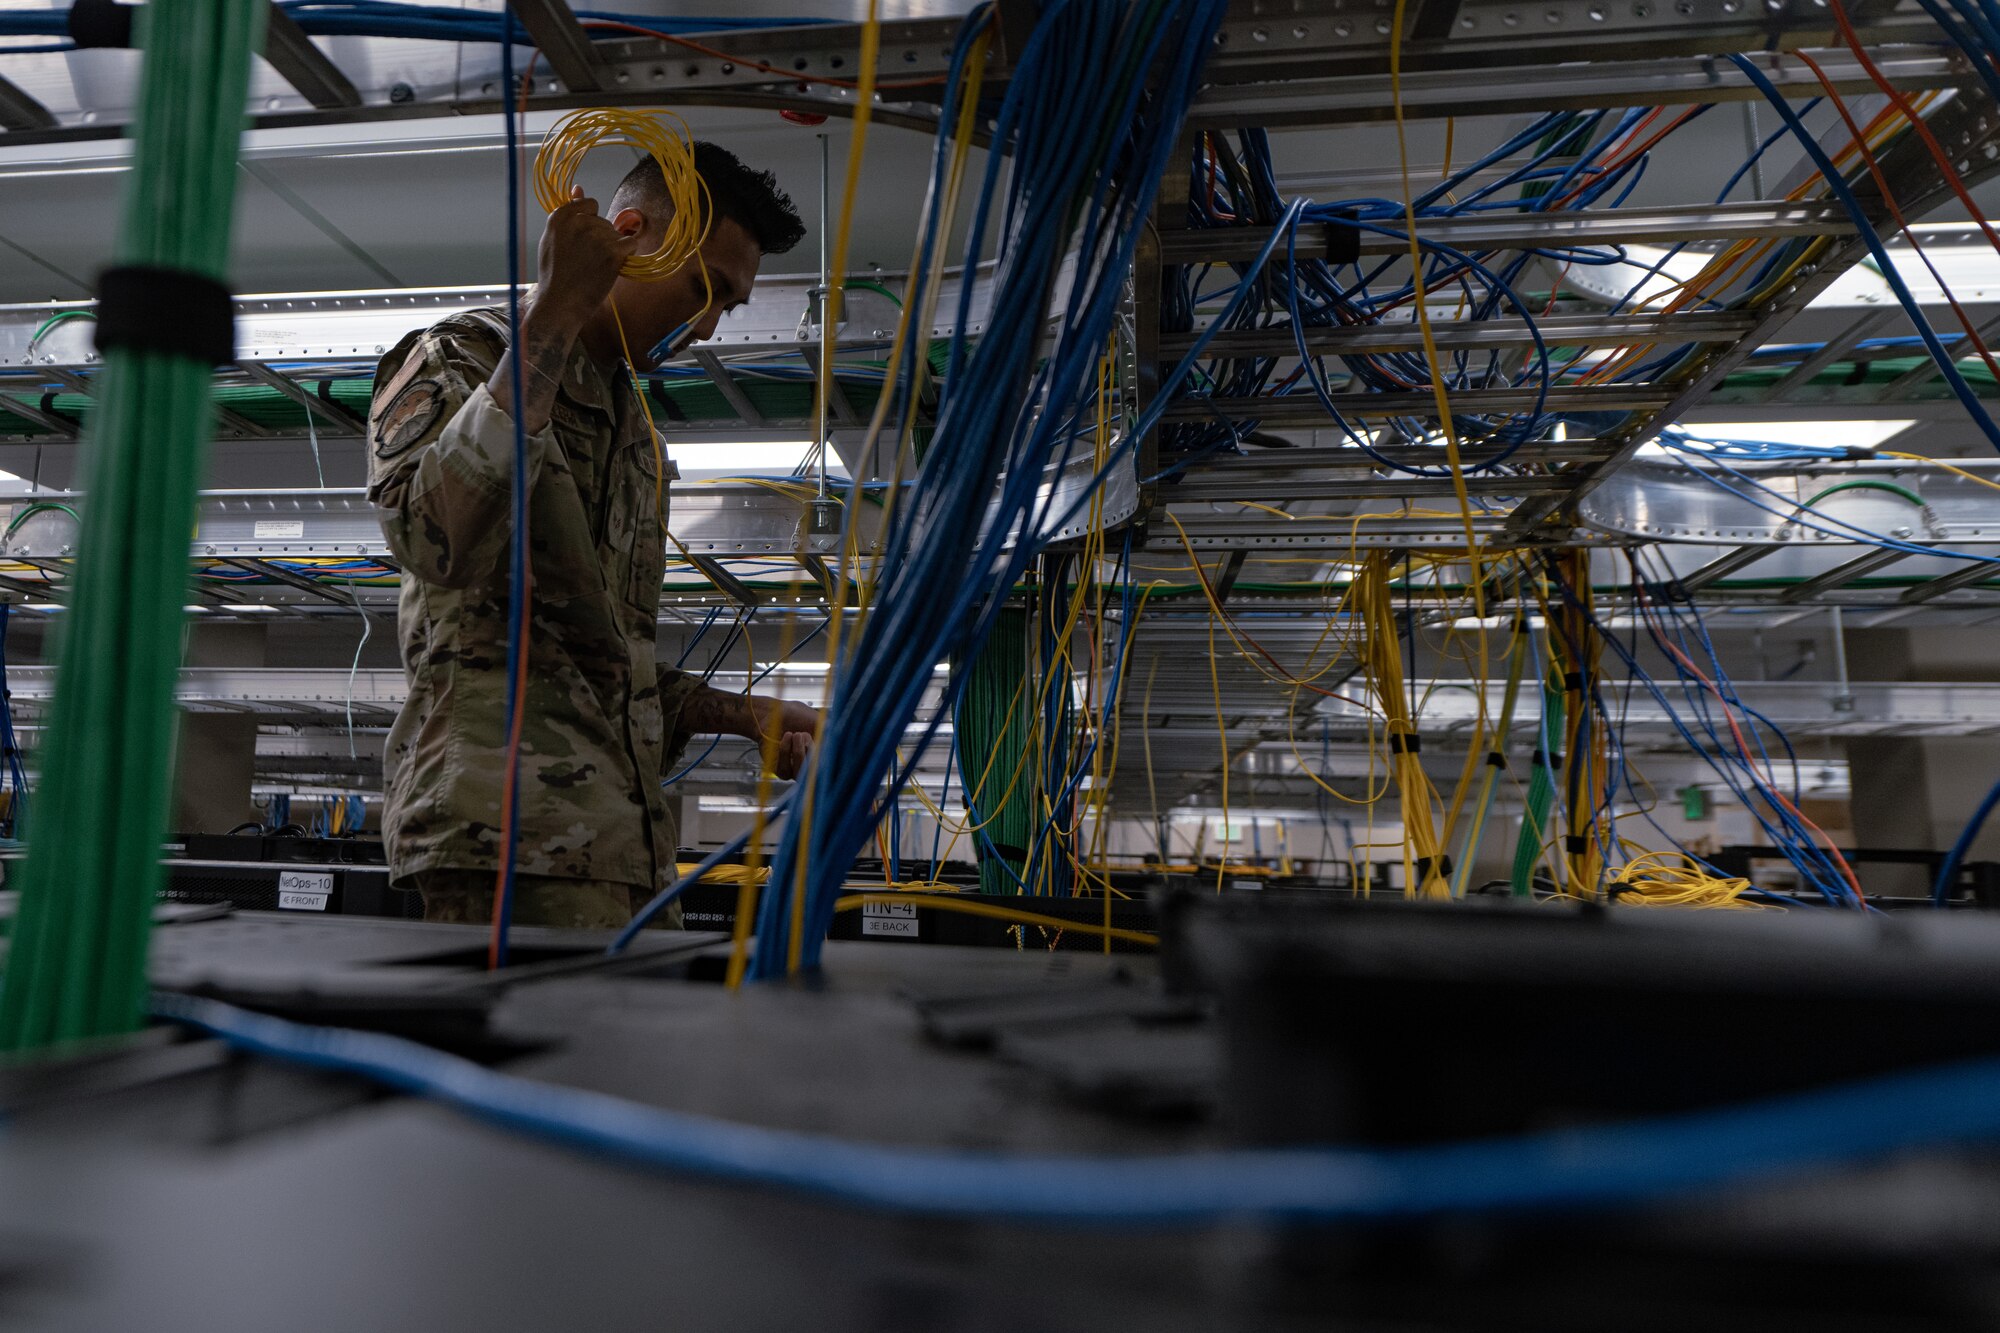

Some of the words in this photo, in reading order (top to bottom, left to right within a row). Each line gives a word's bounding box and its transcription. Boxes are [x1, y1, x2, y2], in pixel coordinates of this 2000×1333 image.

[281, 876, 331, 889] NetOps-10
[291, 896, 320, 905] FRONT
[869, 921, 880, 931] 3E
[882, 922, 910, 932] BACK
